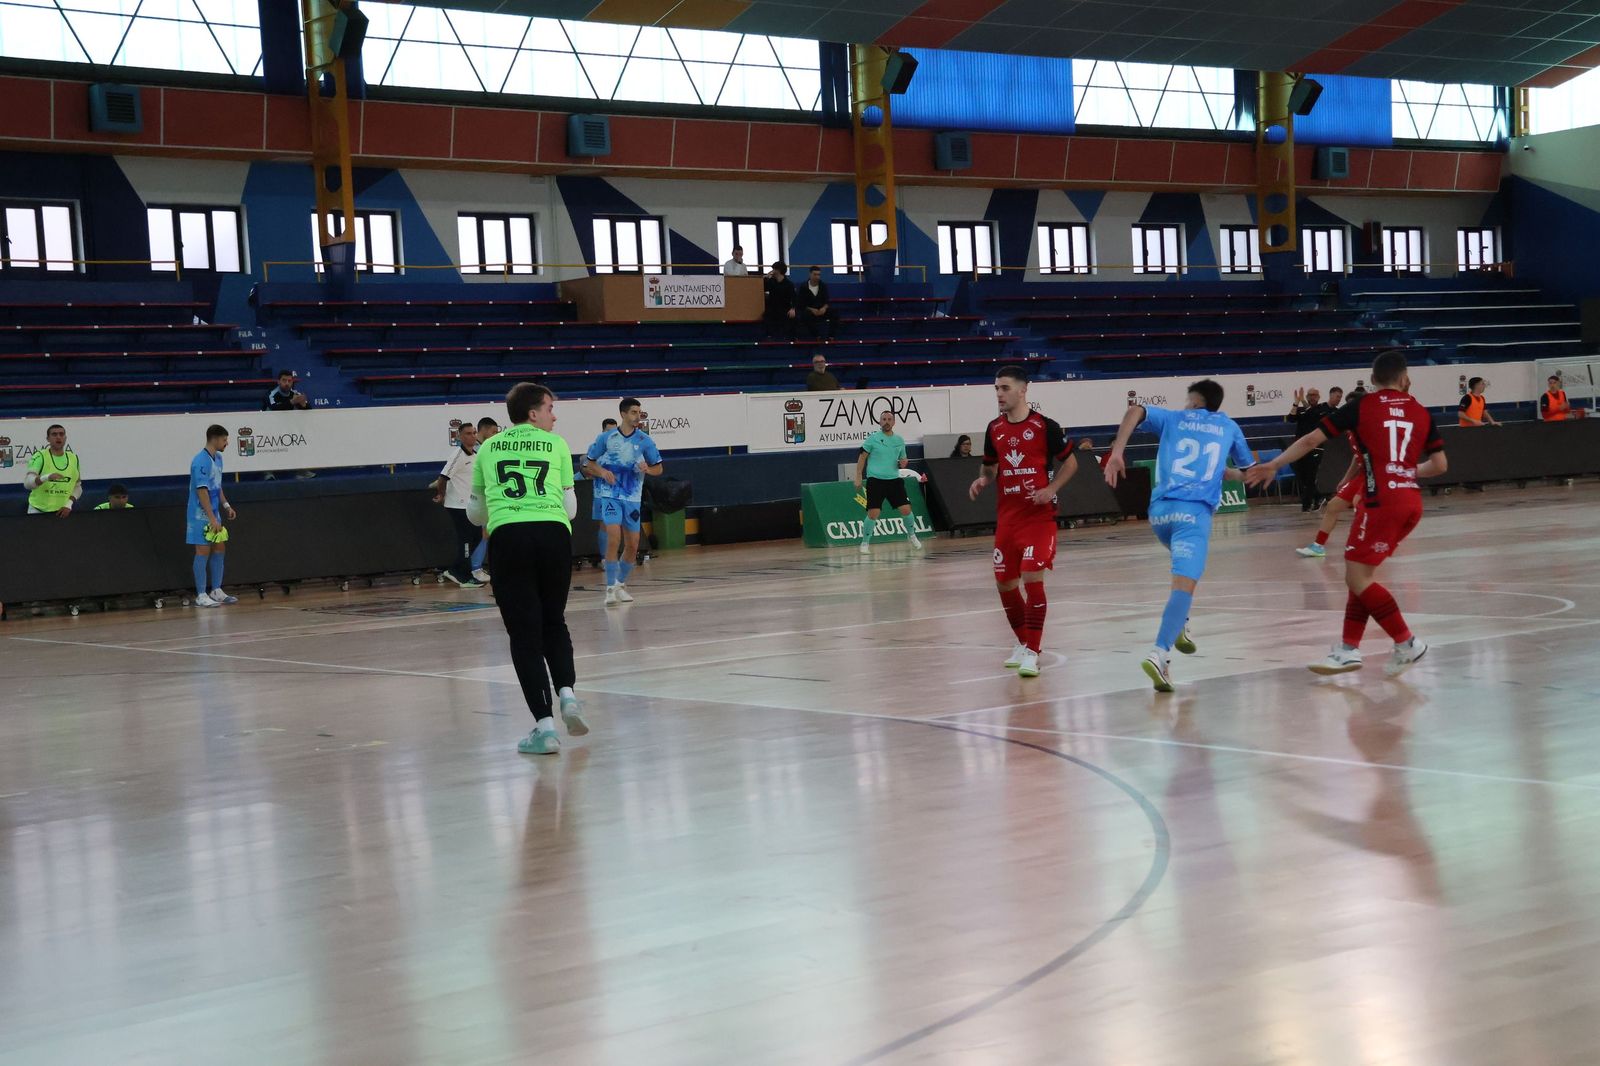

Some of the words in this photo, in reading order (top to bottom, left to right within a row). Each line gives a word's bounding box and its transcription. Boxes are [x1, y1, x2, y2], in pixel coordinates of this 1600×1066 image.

[664, 284, 722, 293] AYUNTAMIENTO
[664, 295, 676, 305] DE
[679, 295, 722, 305] ZAMORA
[238, 330, 253, 338] FILA
[251, 343, 267, 351] FILA
[1137, 395, 1167, 406] ZAMORA
[1255, 390, 1283, 401] ZAMORA
[314, 398, 330, 406] FILA
[819, 396, 922, 428] ZAMORA
[650, 417, 691, 430] ZAMORA
[256, 433, 308, 448] ZAMORA
[820, 430, 877, 442] AYUNTAMIEN
[1384, 420, 1414, 462] 17
[490, 440, 519, 453] PABLO
[520, 440, 553, 453] PRIETO
[1171, 437, 1222, 482] 21
[494, 459, 550, 500] 57
